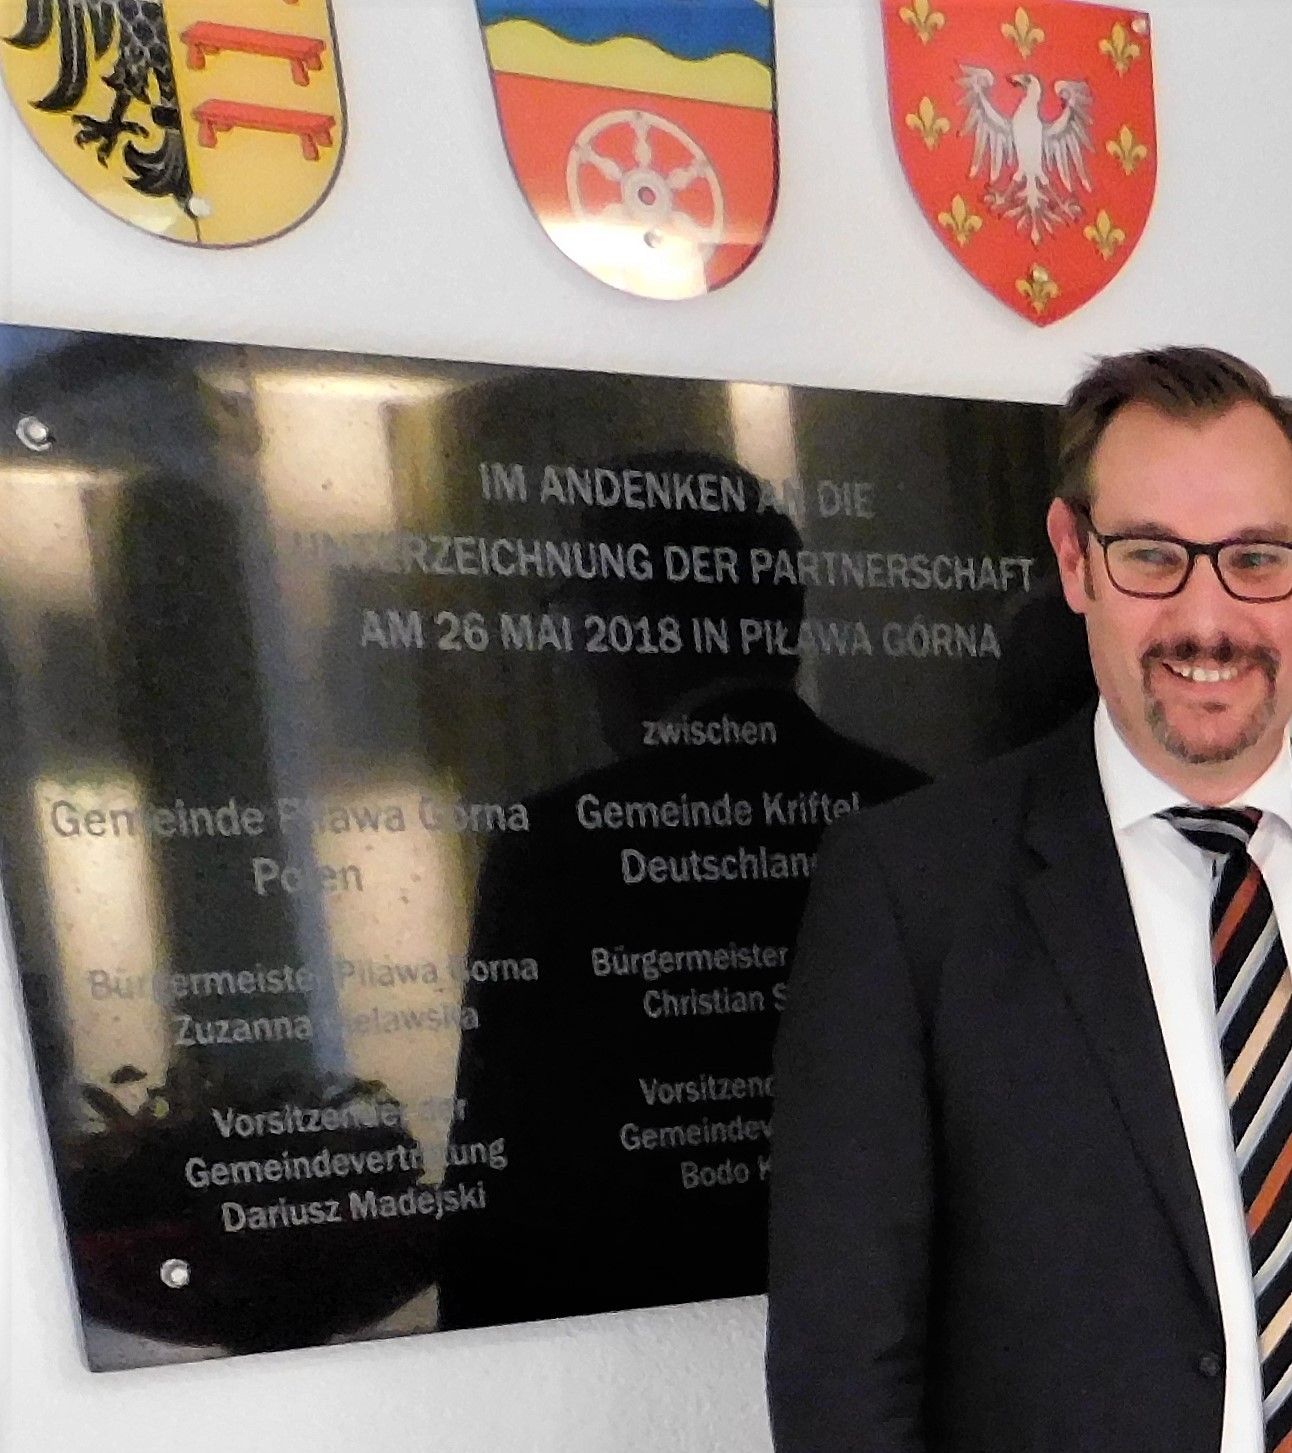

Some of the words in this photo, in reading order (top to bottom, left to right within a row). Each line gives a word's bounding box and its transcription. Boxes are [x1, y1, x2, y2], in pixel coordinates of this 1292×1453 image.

[480, 461, 528, 502] IM
[540, 465, 746, 512] ANDENKEN
[756, 477, 806, 517] AN
[817, 479, 876, 519] DIE
[292, 530, 653, 581] RZEICHNUNG
[664, 543, 740, 585] DER
[750, 549, 1034, 592] PARTNERSCHAFT
[361, 609, 425, 649] AM
[434, 610, 490, 652] 26
[500, 612, 575, 652] MAI
[583, 614, 683, 655] 2018
[691, 616, 731, 656] IN
[641, 713, 777, 745] zwischen
[575, 792, 752, 829] Gemeinde
[762, 790, 861, 826] Kriftel
[252, 855, 365, 898] Poen
[591, 941, 789, 981] Bürgermeister
[87, 964, 328, 1003] Bürermeiste
[643, 986, 765, 1019] Christian
[174, 1012, 313, 1048] Zuzanna
[638, 1073, 775, 1106] Vorsitzen
[211, 1100, 408, 1139] Vorsitzende
[619, 1114, 773, 1151] Gemeindev
[184, 1137, 508, 1190] Gemeindevertrung
[680, 1158, 750, 1189] Bodo
[221, 1198, 343, 1234] Dariusz
[349, 1180, 487, 1221] Madejski
